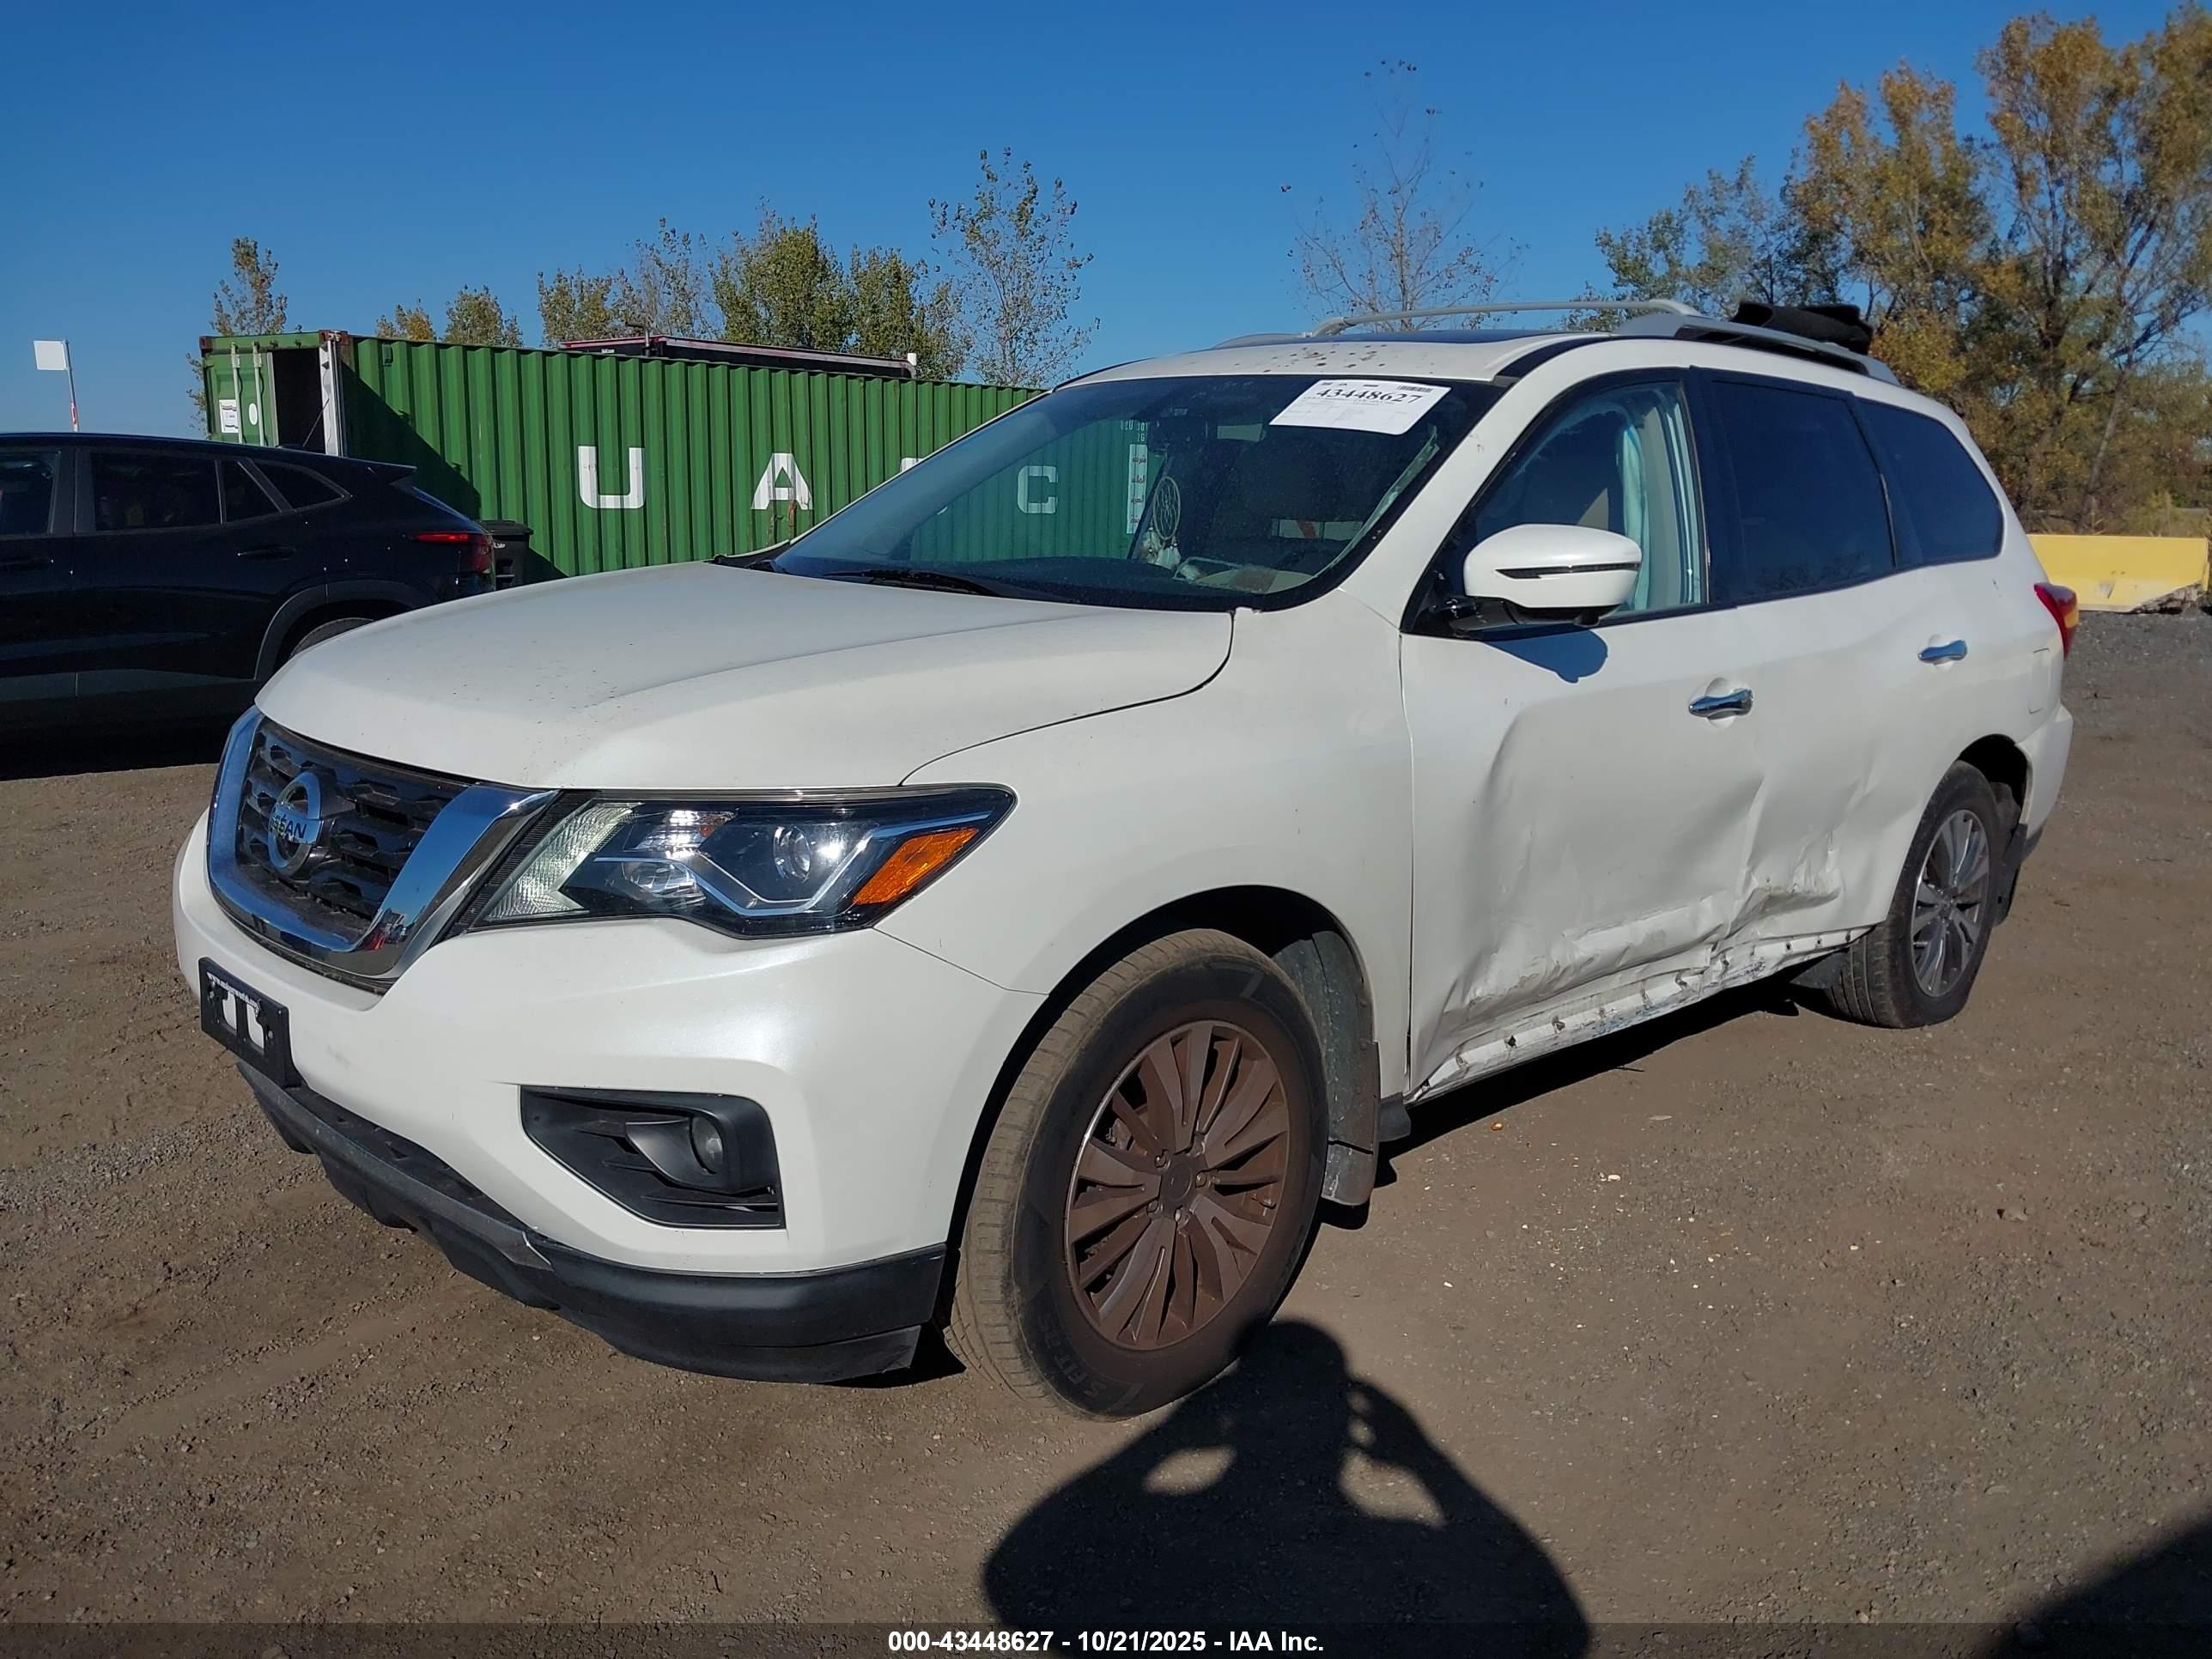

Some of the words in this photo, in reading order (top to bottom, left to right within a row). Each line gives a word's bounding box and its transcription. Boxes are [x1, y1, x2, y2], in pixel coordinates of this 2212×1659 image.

[1316, 388, 1423, 404] 43448627
[578, 445, 645, 509] U
[750, 453, 813, 510] A
[1018, 465, 1058, 514] C
